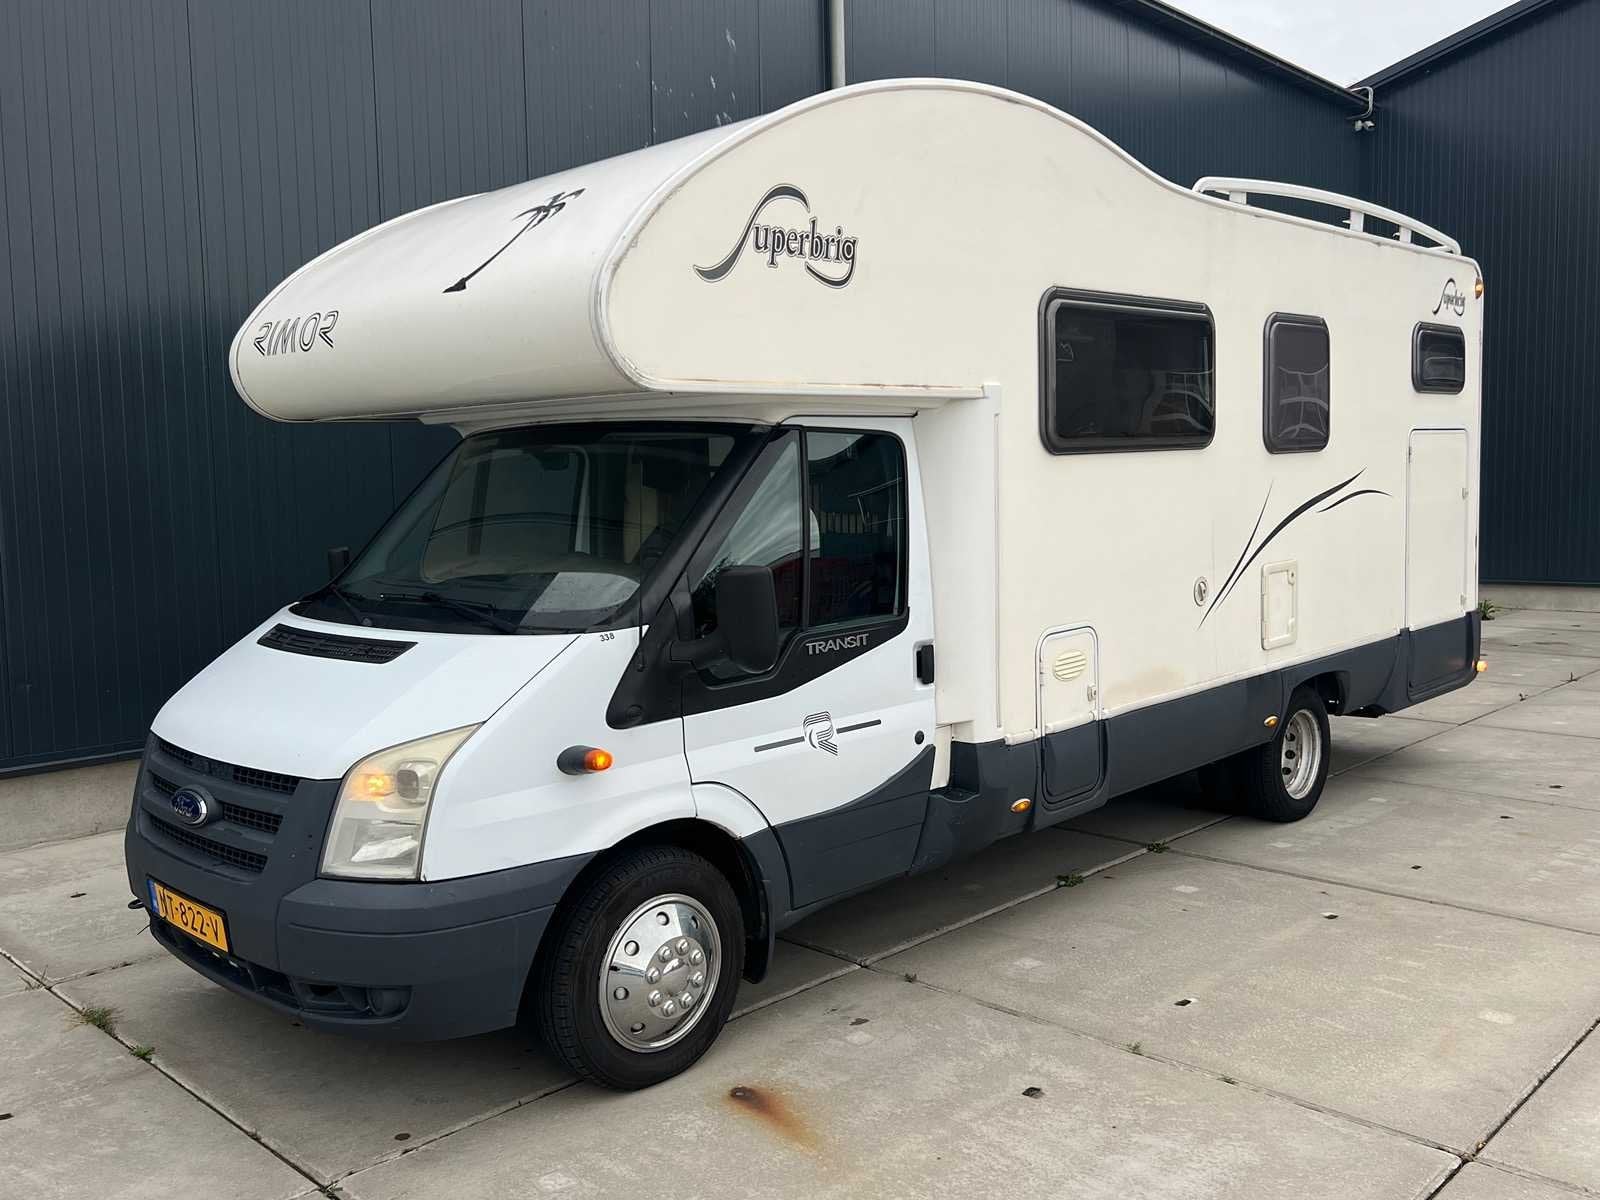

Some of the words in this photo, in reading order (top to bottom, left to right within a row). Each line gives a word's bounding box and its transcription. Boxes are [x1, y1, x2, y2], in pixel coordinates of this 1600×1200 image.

[693, 183, 858, 289] Superbrig
[254, 310, 339, 356] RIMOR
[600, 632, 615, 642] 338
[805, 633, 870, 656] TRANSIT
